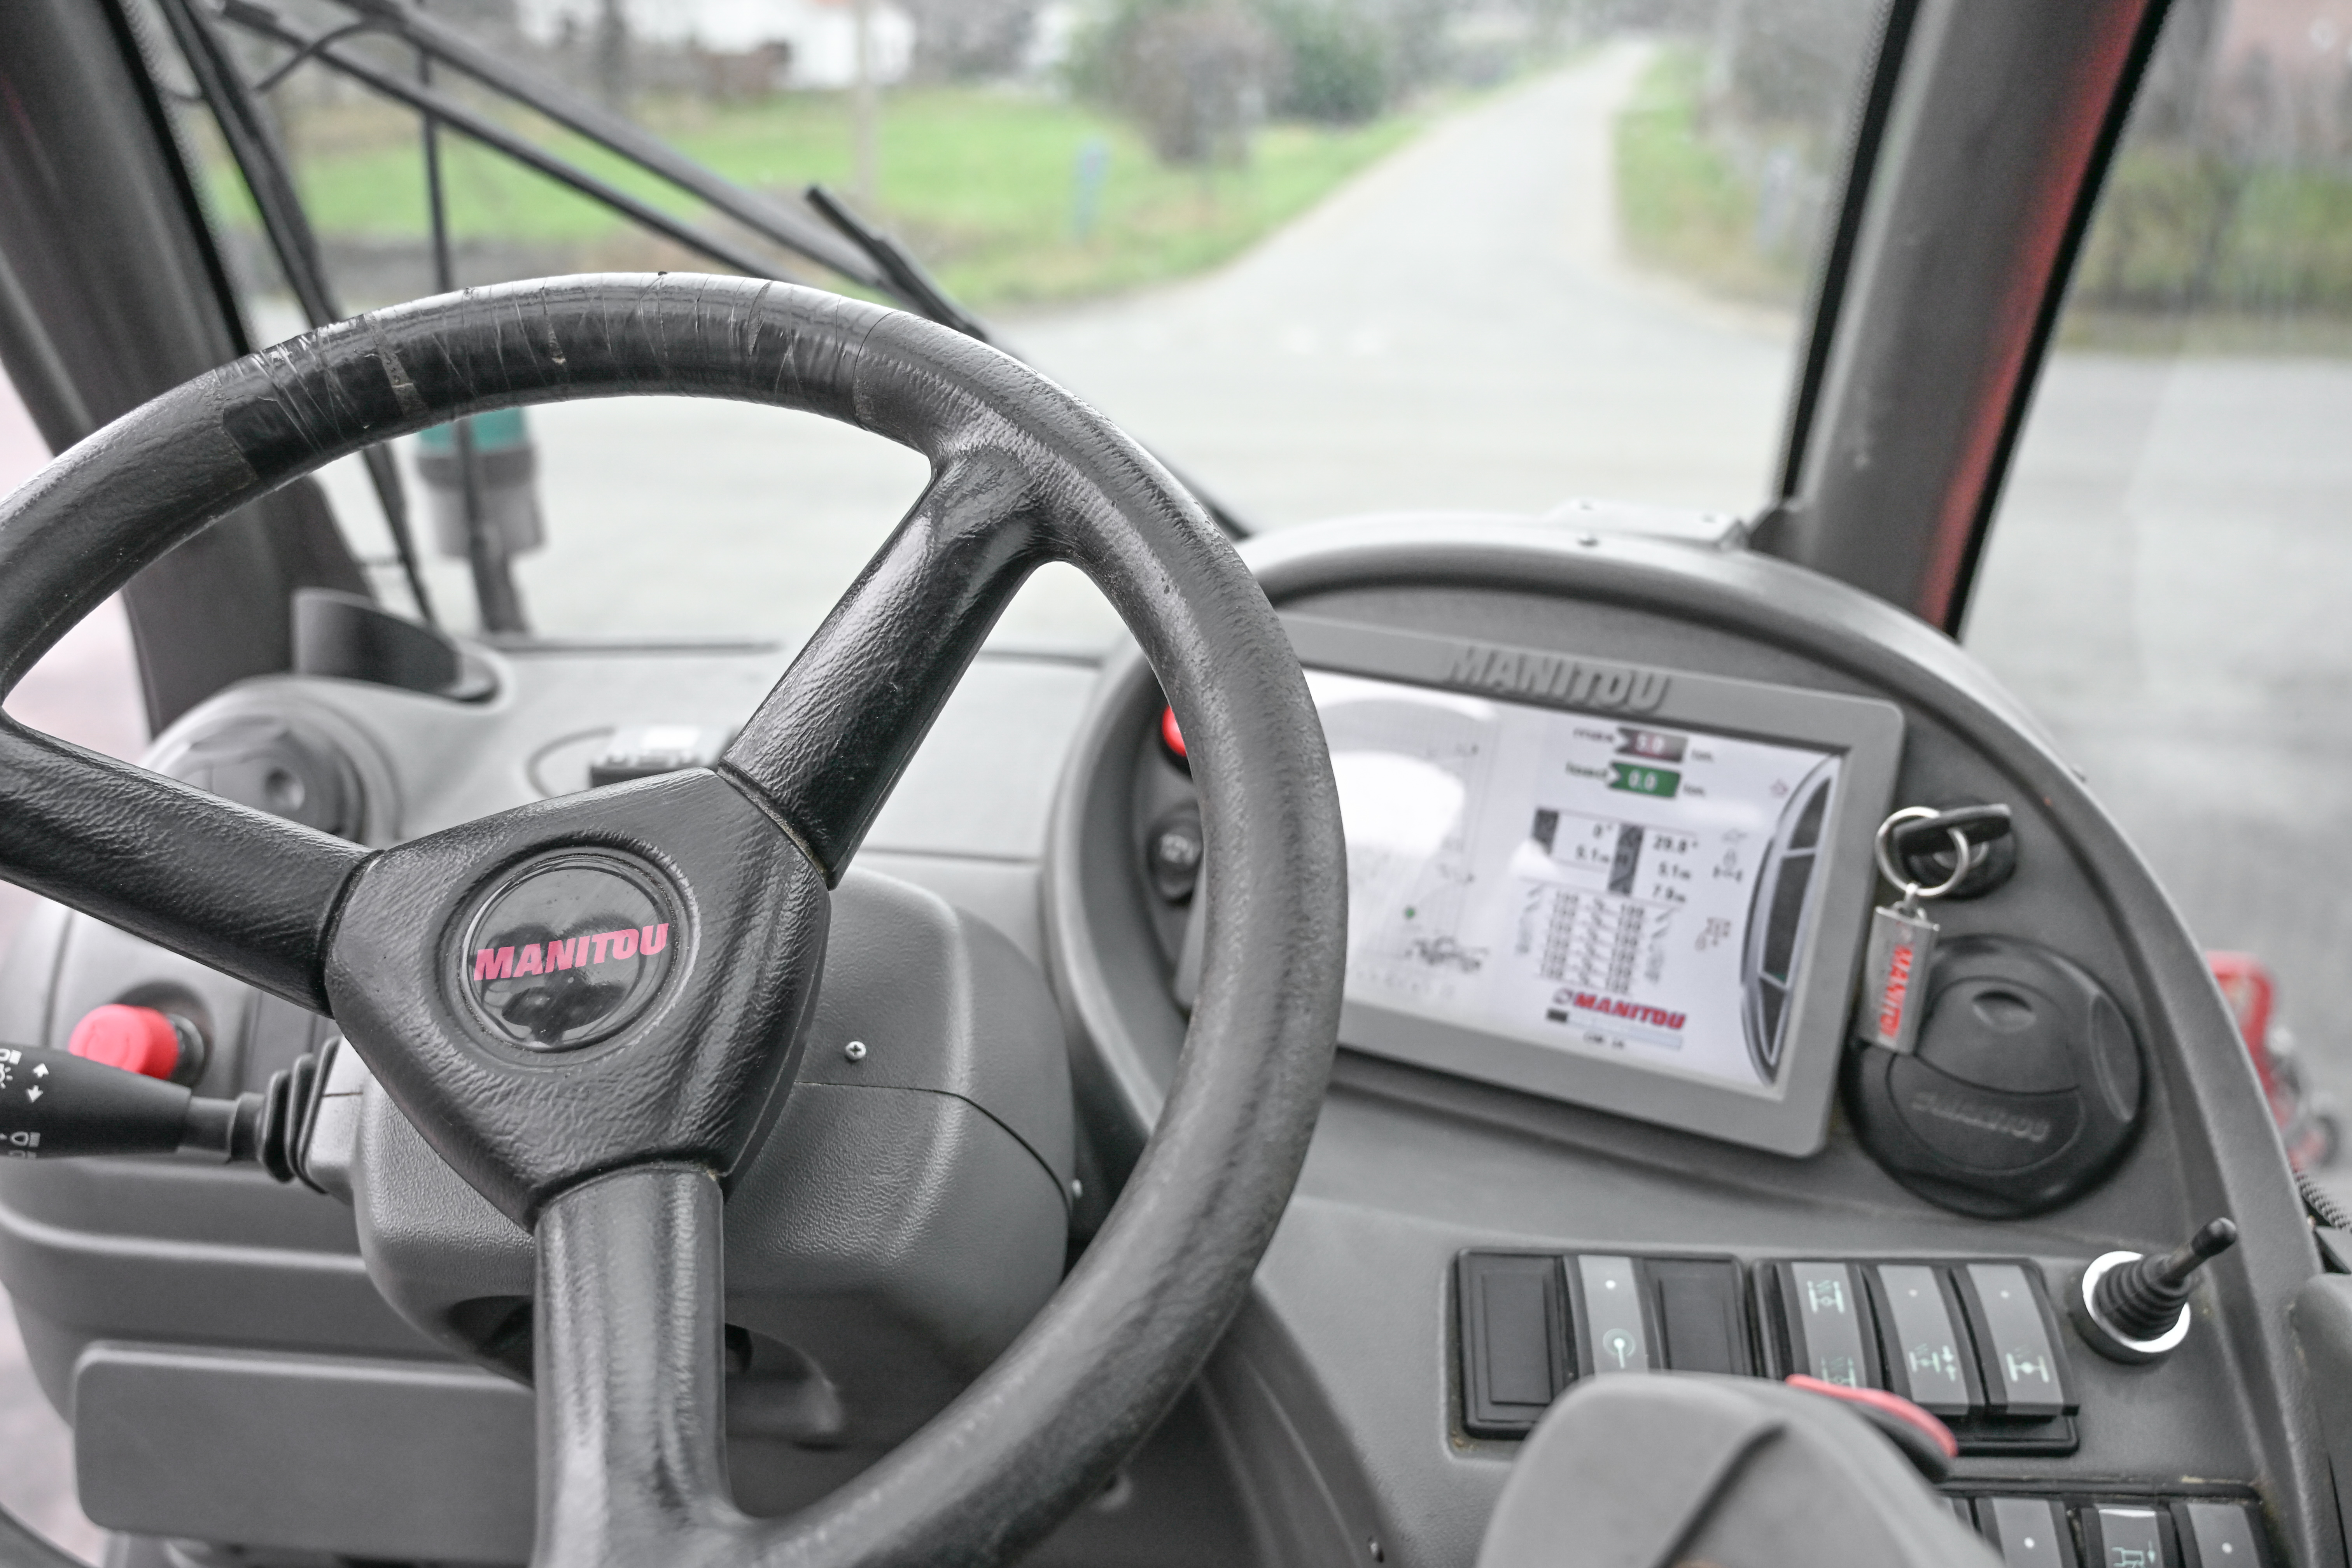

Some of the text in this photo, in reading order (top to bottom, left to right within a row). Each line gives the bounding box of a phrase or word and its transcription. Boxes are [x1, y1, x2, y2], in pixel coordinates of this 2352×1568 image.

[1444, 645, 1672, 714] MANITOU
[473, 923, 669, 981] MANITOU
[1573, 991, 1687, 1031] MANITOU
